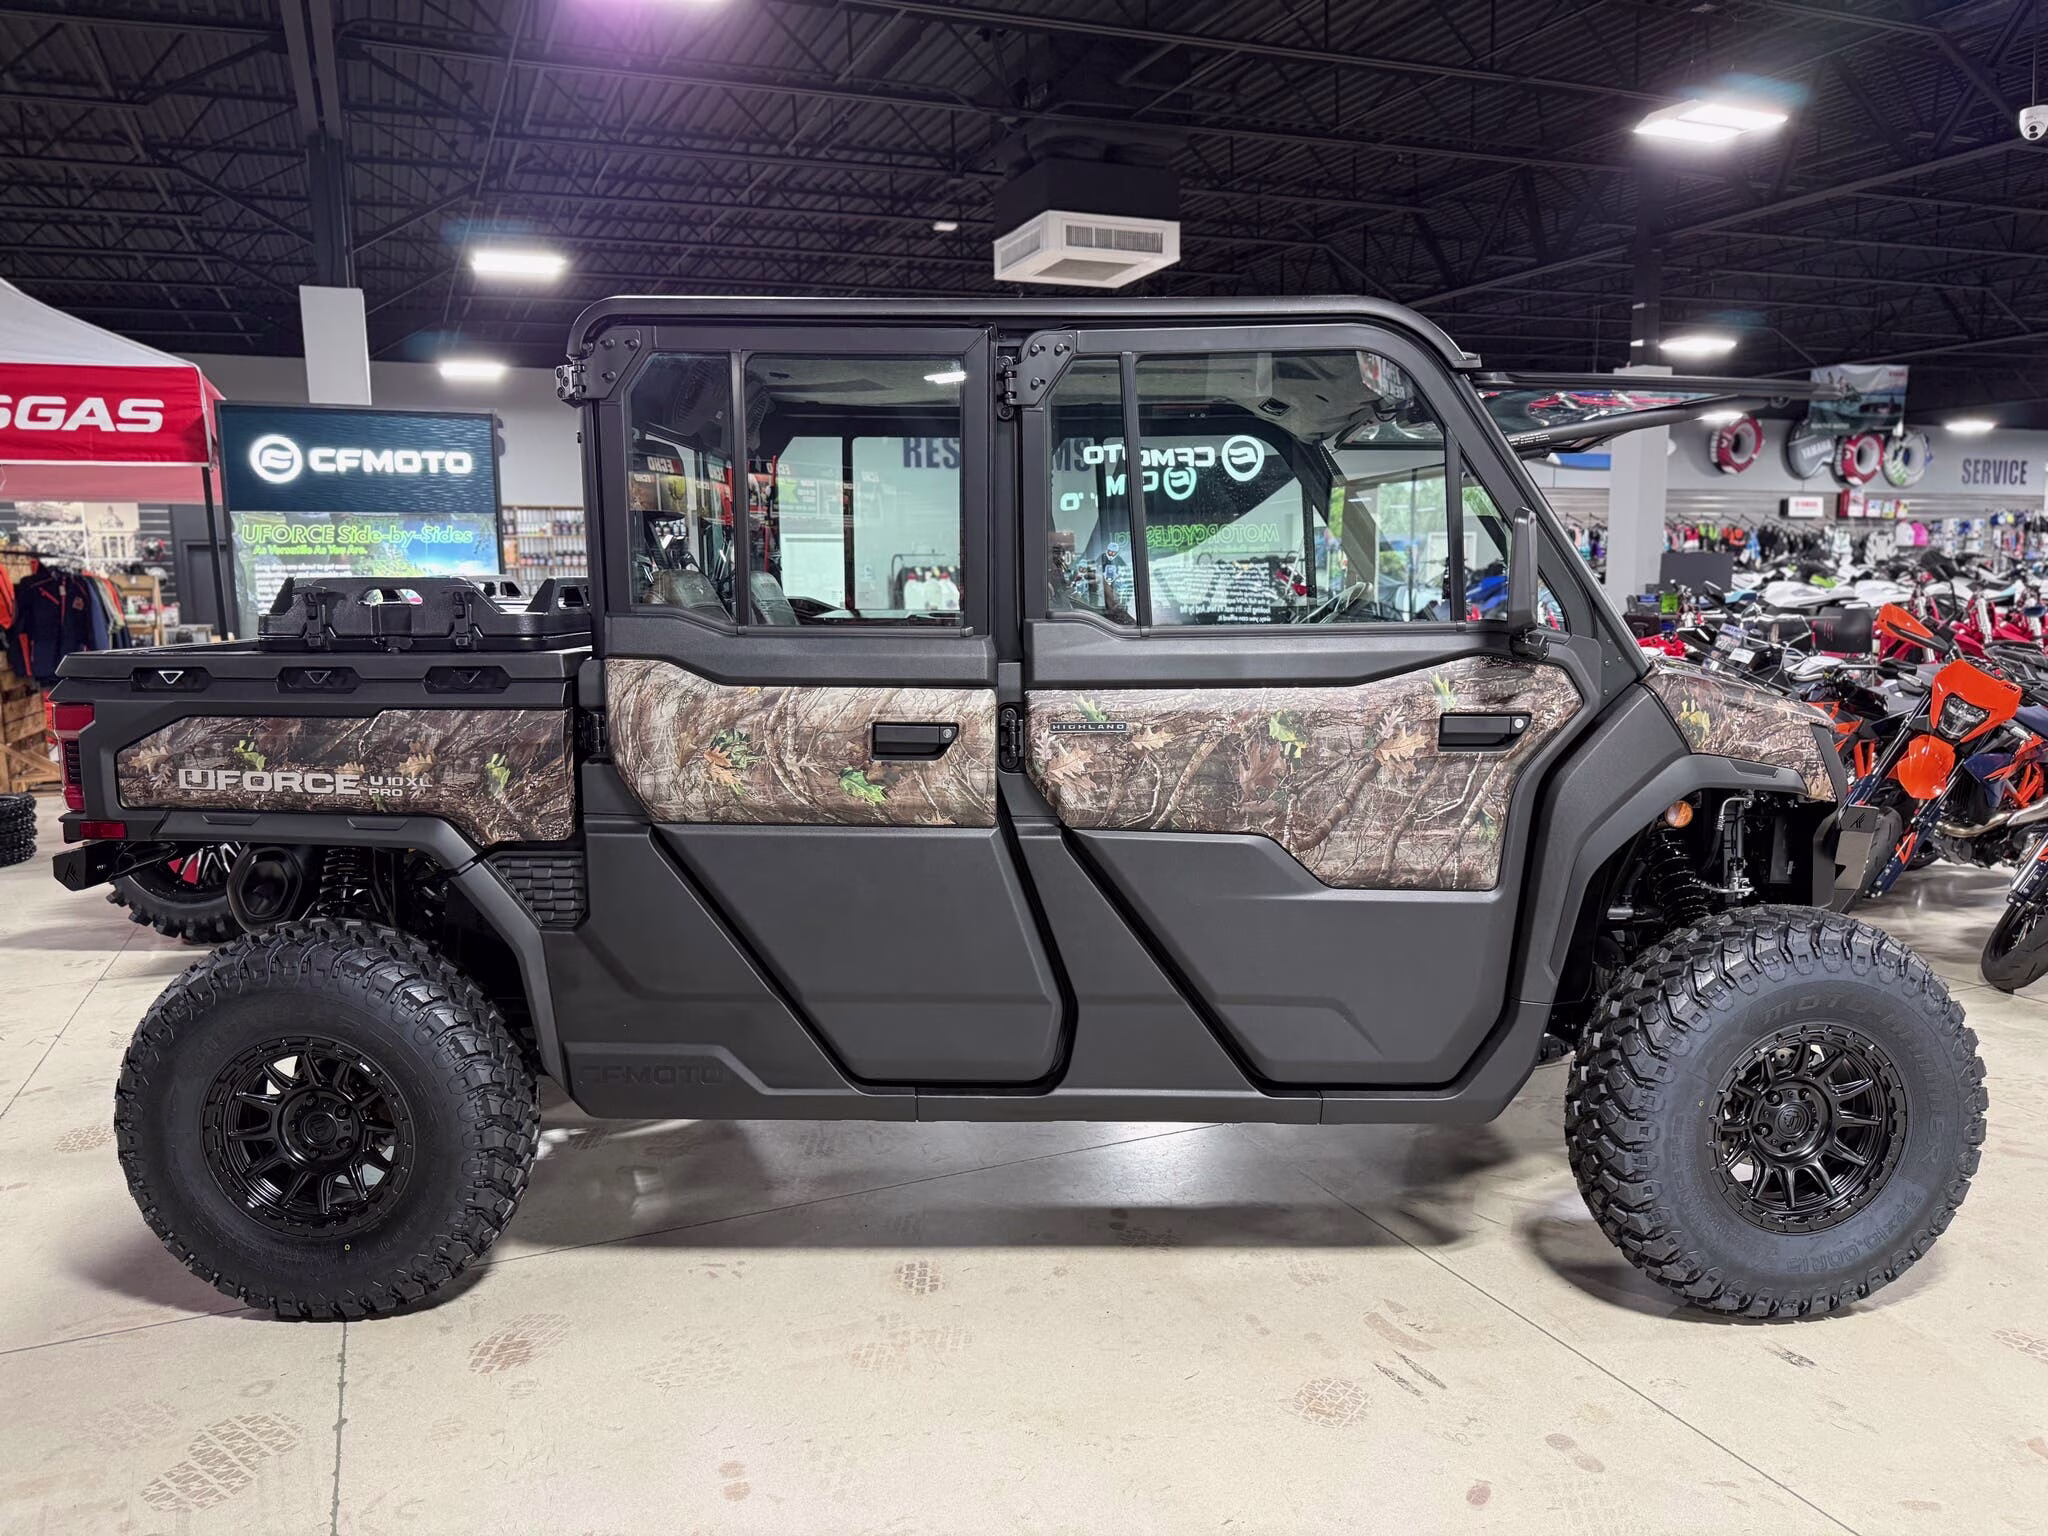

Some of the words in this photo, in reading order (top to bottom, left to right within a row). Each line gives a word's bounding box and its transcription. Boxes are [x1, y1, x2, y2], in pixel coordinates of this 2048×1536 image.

[0, 394, 165, 433] GAS
[308, 447, 473, 475] CFMOTO
[1961, 458, 2028, 485] SERVICE
[242, 524, 335, 544] UFORCE
[337, 523, 473, 549] Side-by-Sides
[178, 768, 363, 795] UFORCE
[368, 787, 403, 797] PRO
